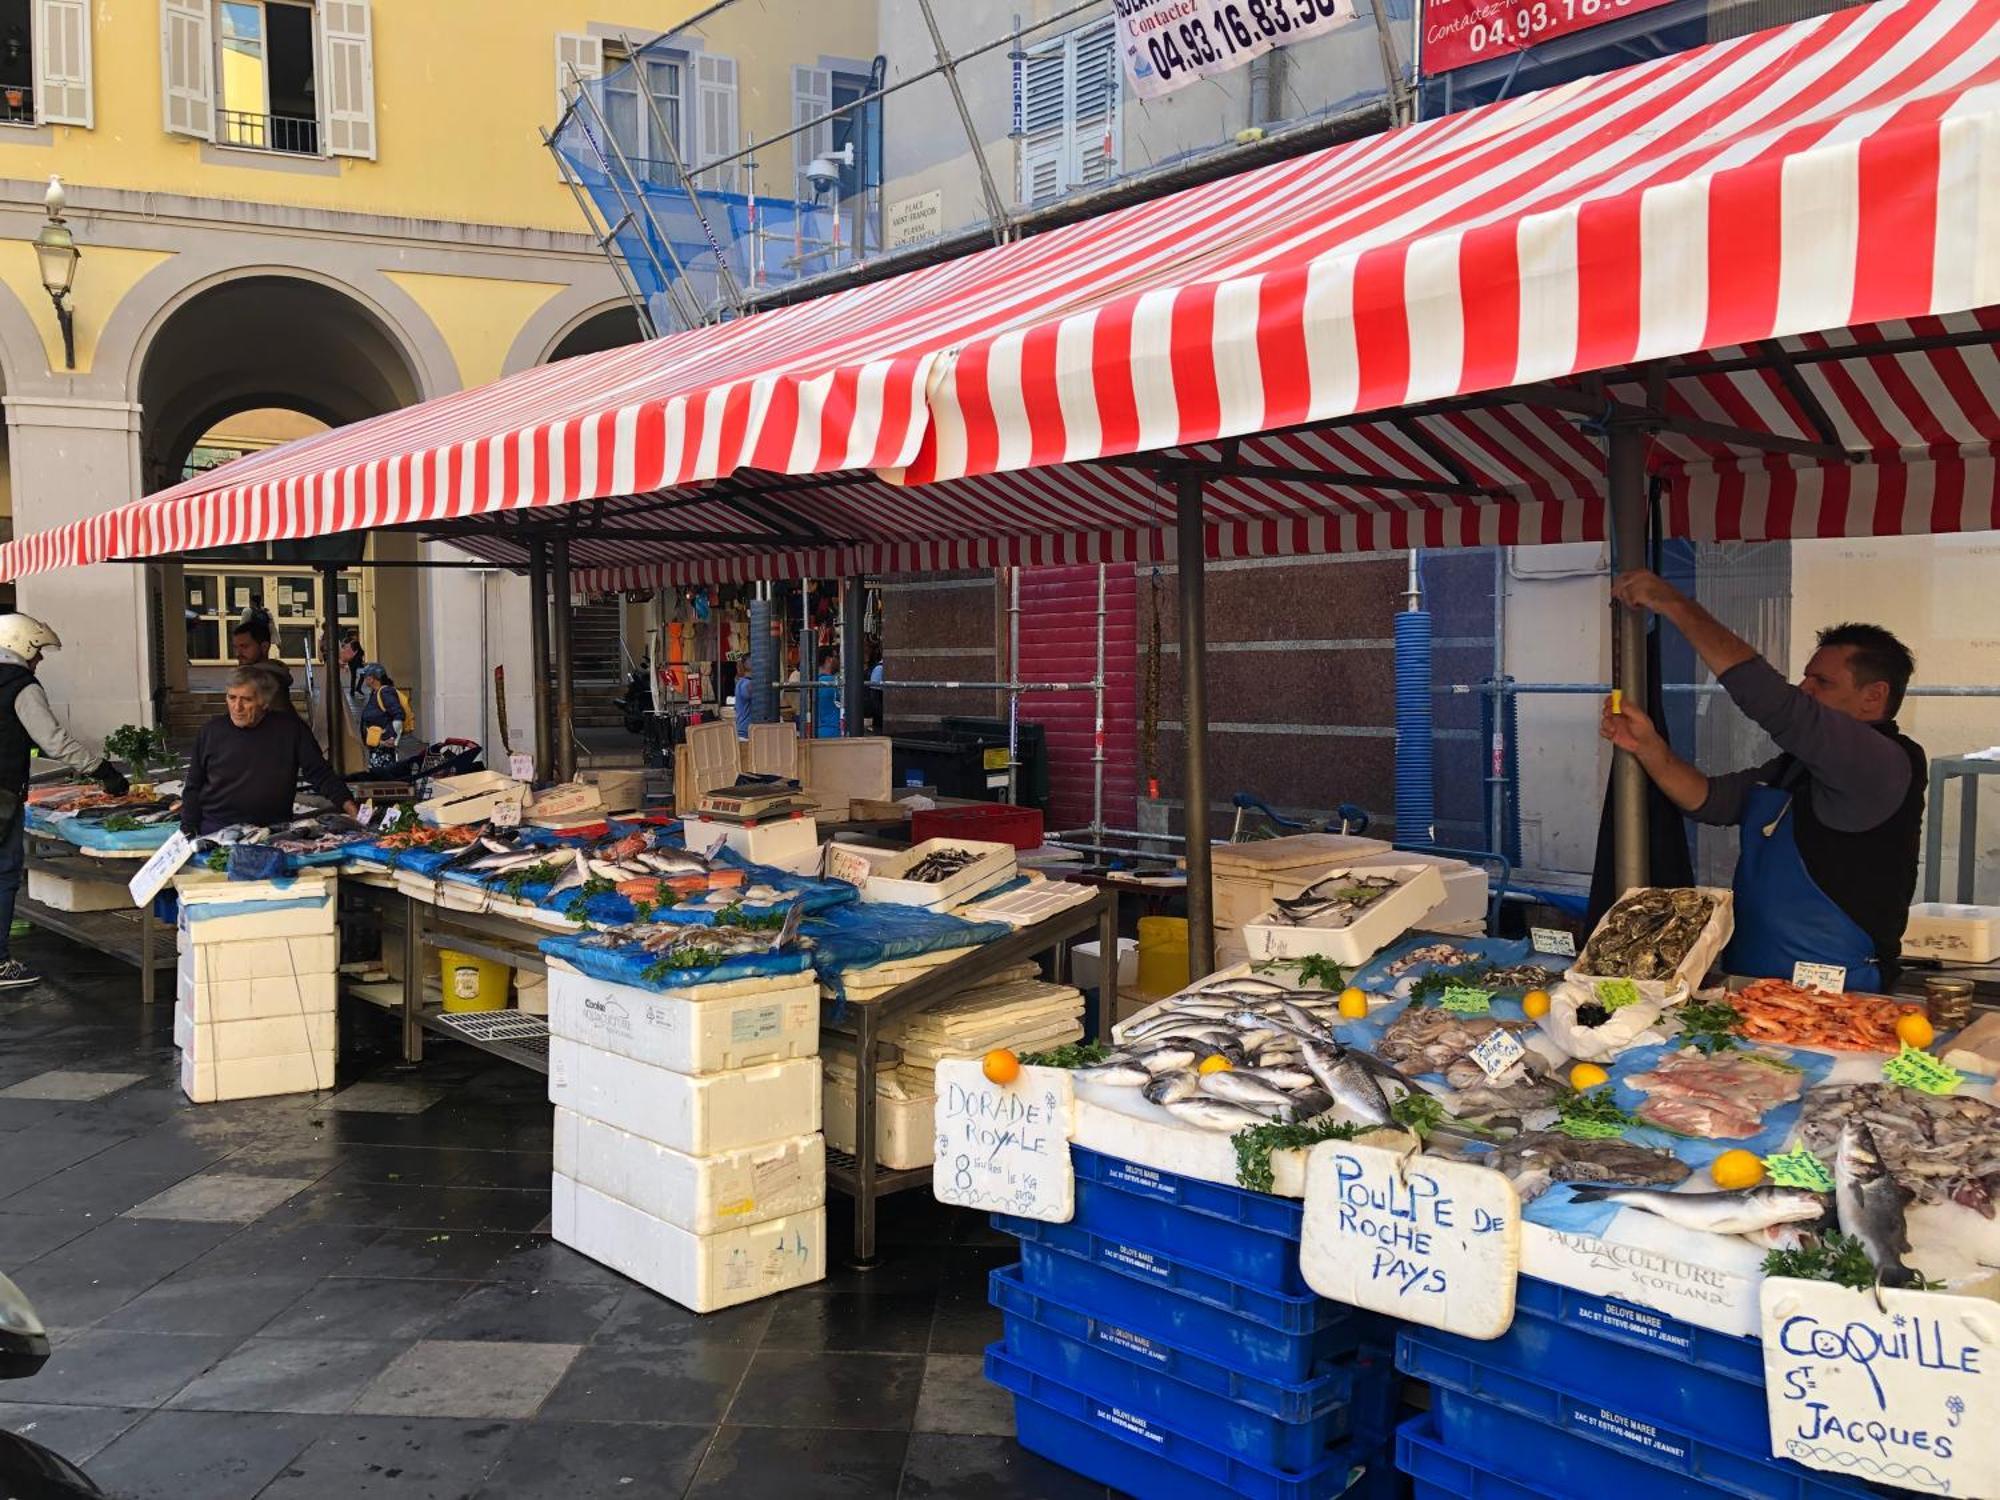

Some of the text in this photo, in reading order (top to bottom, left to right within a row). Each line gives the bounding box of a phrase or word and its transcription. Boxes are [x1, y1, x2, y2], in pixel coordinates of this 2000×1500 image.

[1129, 0, 1198, 37] Contactez
[905, 200, 923, 214] PLACE
[946, 1081, 1040, 1125] DORADE
[966, 1118, 1048, 1160] ROYALE
[955, 1154, 972, 1190] 8
[1340, 1202, 1432, 1255] ROCHE
[1471, 1208, 1505, 1233] DE
[1373, 1247, 1447, 1296] PAYS
[1549, 1231, 1727, 1289] AQUACULTURE
[1631, 1271, 1730, 1307] SCOTLAND
[1579, 1307, 1593, 1319] ZAC
[1593, 1312, 1602, 1321] ST
[1648, 1328, 1658, 1338] ST
[1658, 1331, 1689, 1348] JEANNET
[1605, 1303, 1662, 1329] DELOYE MAREE
[1574, 1411, 1588, 1423] ZAC
[1588, 1417, 1597, 1426] ST
[1643, 1437, 1653, 1446] ST
[1653, 1441, 1685, 1458] JEANNET
[1600, 1409, 1657, 1437] DELOYE MAREE
[1798, 1402, 1953, 1459] JACQUES
